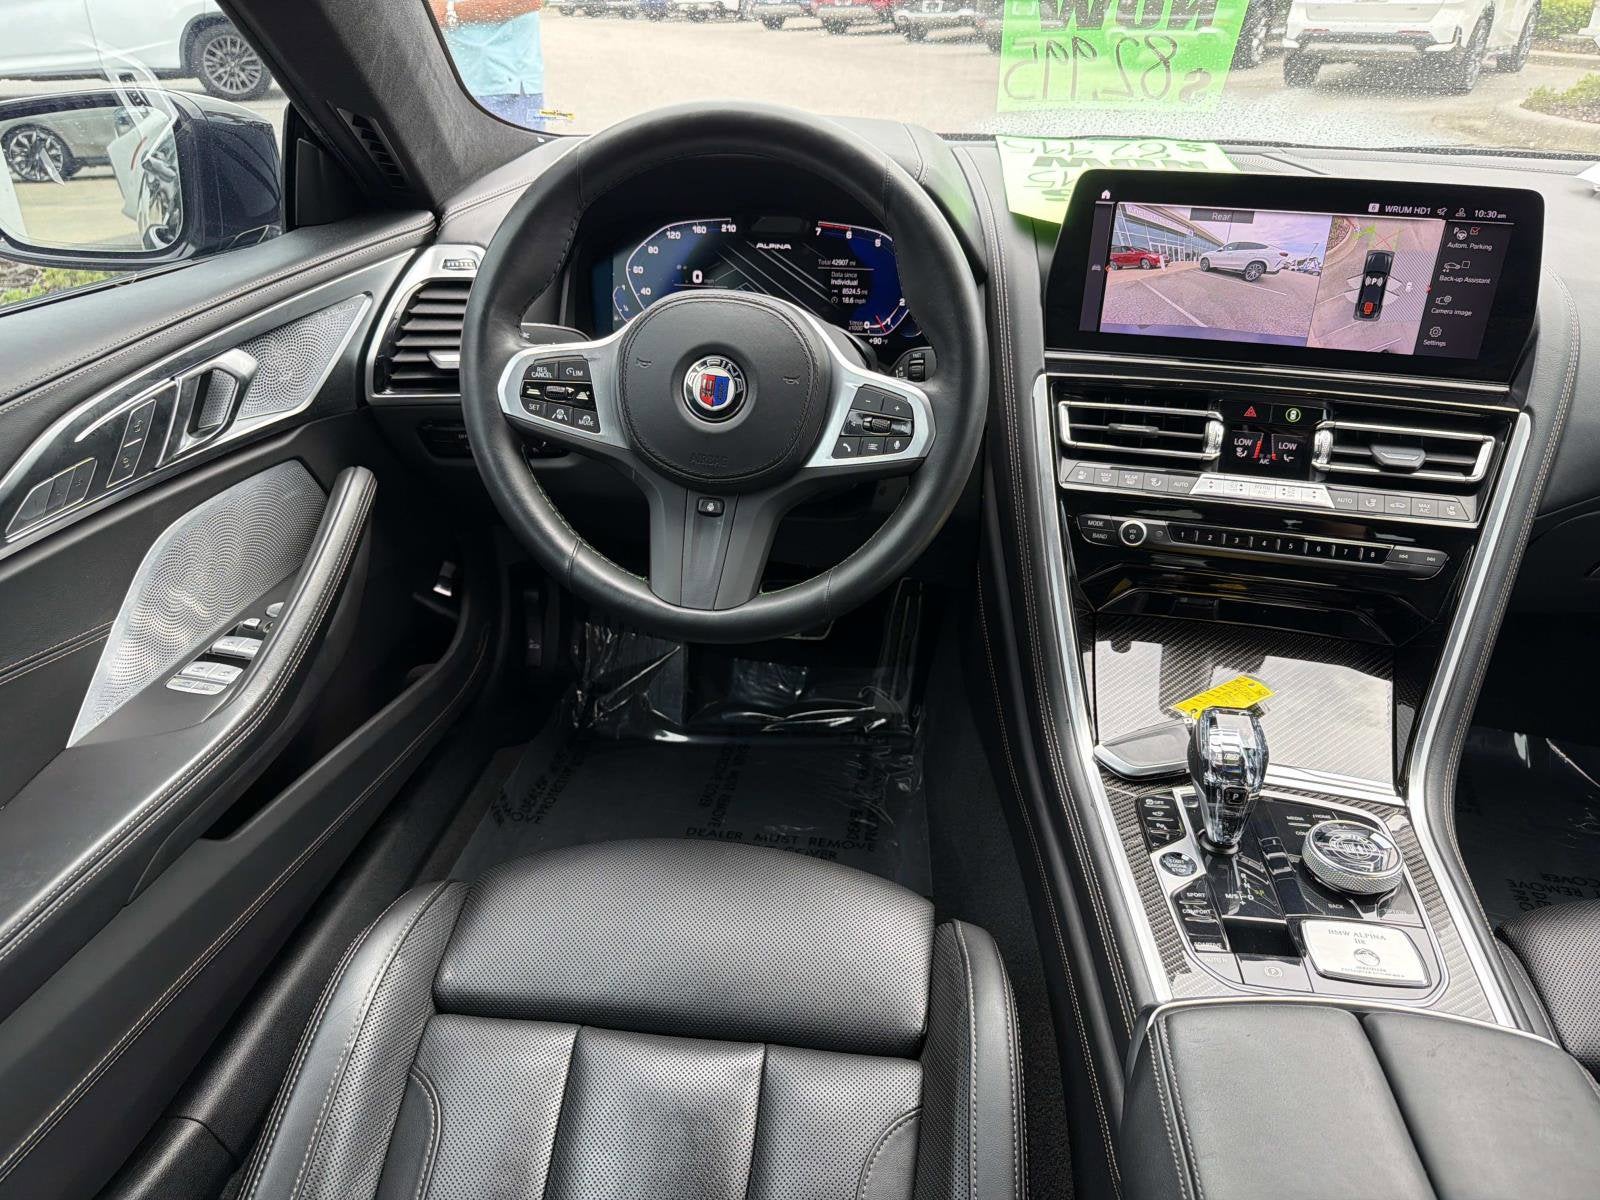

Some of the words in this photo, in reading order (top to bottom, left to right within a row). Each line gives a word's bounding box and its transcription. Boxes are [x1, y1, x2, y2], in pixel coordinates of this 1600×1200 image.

[1385, 205, 1412, 214] WRUM
[1414, 206, 1431, 214] HD1
[1474, 209, 1497, 218] 10:30
[1211, 212, 1230, 221] Rear
[692, 226, 707, 234] 160
[721, 224, 737, 233] 210
[815, 227, 822, 236] 7
[666, 231, 681, 239] 120
[648, 246, 658, 254] 80
[756, 242, 792, 250] ALPINA
[1470, 243, 1493, 251] Parking
[633, 266, 644, 274] 60
[692, 270, 703, 284] 0
[1464, 276, 1491, 284] Assistant
[640, 287, 651, 296] 40
[864, 320, 870, 329] 0
[868, 337, 883, 345] +90
[1424, 339, 1447, 347] Settings
[687, 359, 744, 394] ALPINA
[1234, 438, 1251, 447] LOW
[1278, 441, 1297, 450] LOW
[1336, 497, 1353, 505] AUTO
[1087, 519, 1105, 527] MODE
[686, 827, 743, 841] DEALER
[753, 833, 799, 845] MUST
[808, 837, 875, 853] REMOVE
[1354, 931, 1387, 941] ALPINA
